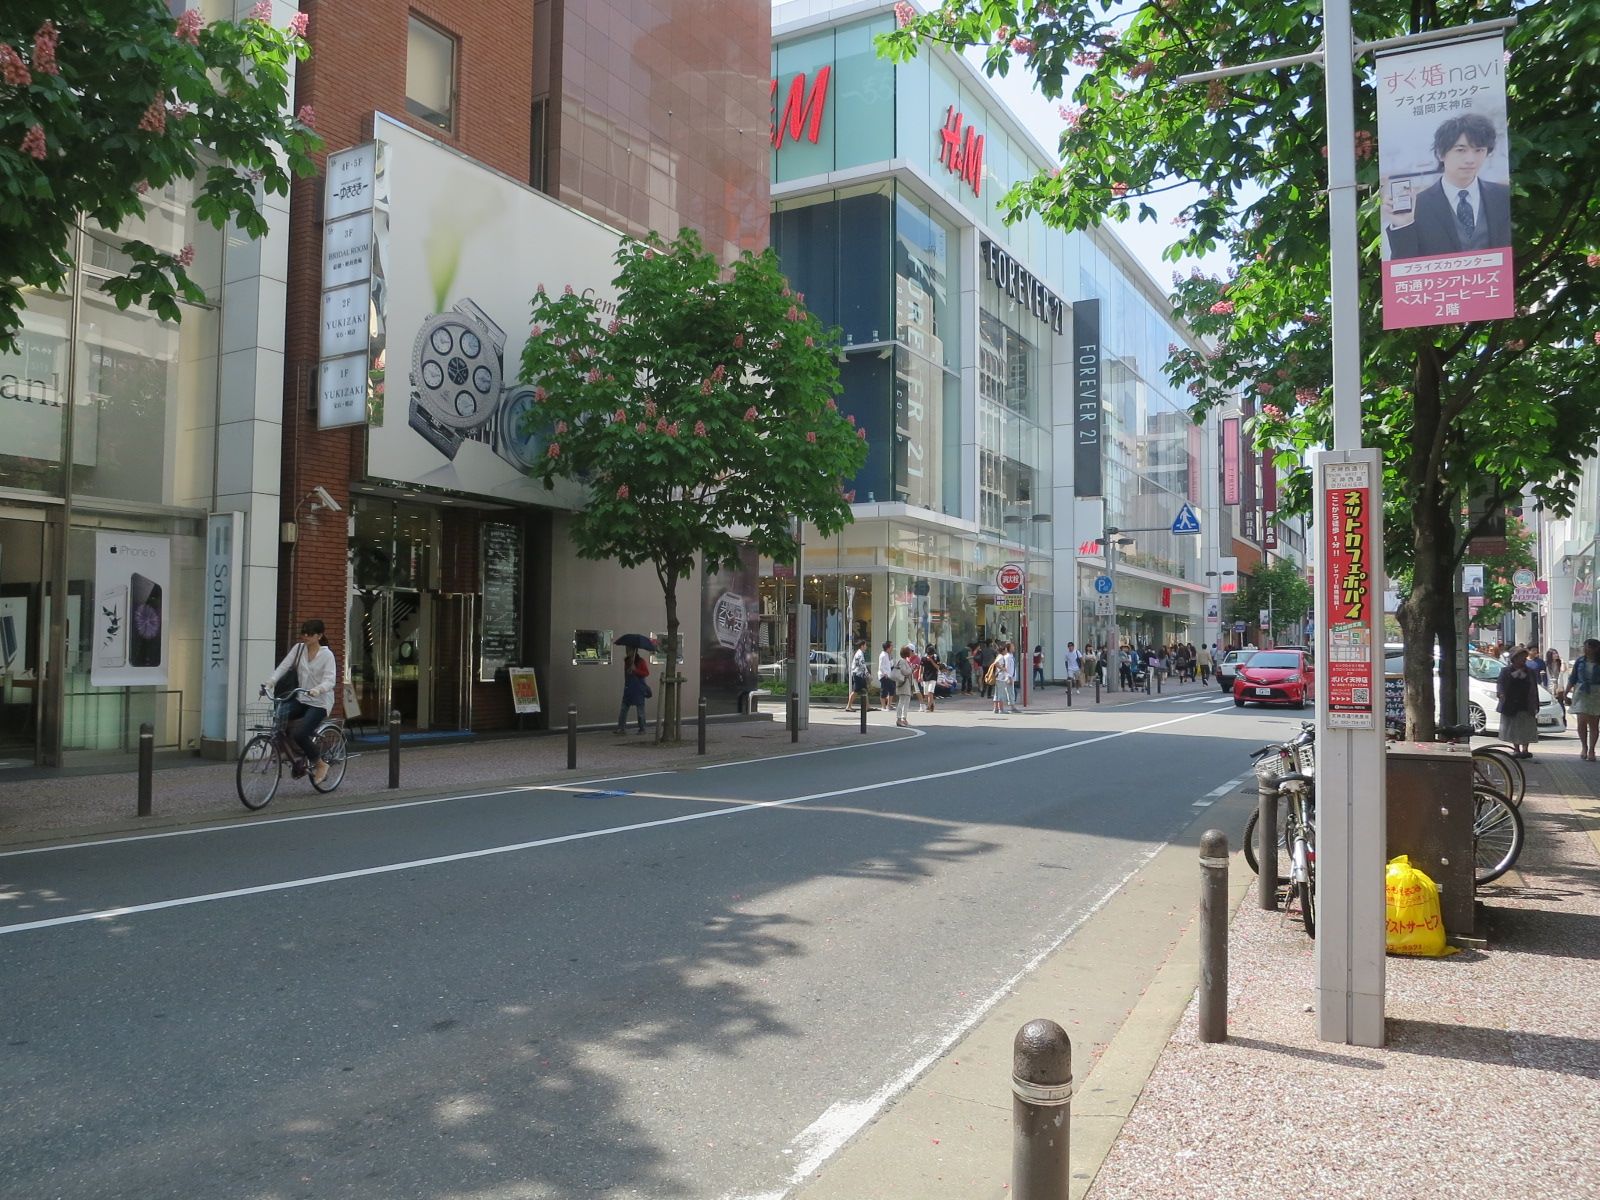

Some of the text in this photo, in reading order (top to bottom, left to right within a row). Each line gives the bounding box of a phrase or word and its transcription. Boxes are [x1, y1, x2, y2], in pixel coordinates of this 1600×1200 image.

[1394, 85, 1490, 107] ブライズカウンター
[1413, 98, 1473, 117] 福岡天神店
[939, 105, 983, 198] H&M
[350, 243, 369, 255] ROOM
[1404, 257, 1493, 274] ブライズカウンター
[984, 241, 1064, 335] FOREVER 21
[1394, 270, 1500, 294] 西通りシアトルズ
[342, 298, 351, 308] 2F
[1396, 285, 1500, 305] ベストコーヒー上
[1435, 303, 1461, 317] 2階
[326, 312, 366, 330] YUKIZAKI
[907, 254, 926, 420] FOREER
[340, 369, 349, 378] 1F
[324, 386, 364, 400] YUKIZAKI
[1079, 344, 1097, 446] FOREVER 21
[120, 545, 149, 557] iPhone
[1343, 491, 1366, 619] ネットカフェポパイ
[211, 564, 228, 671] SoftBank
